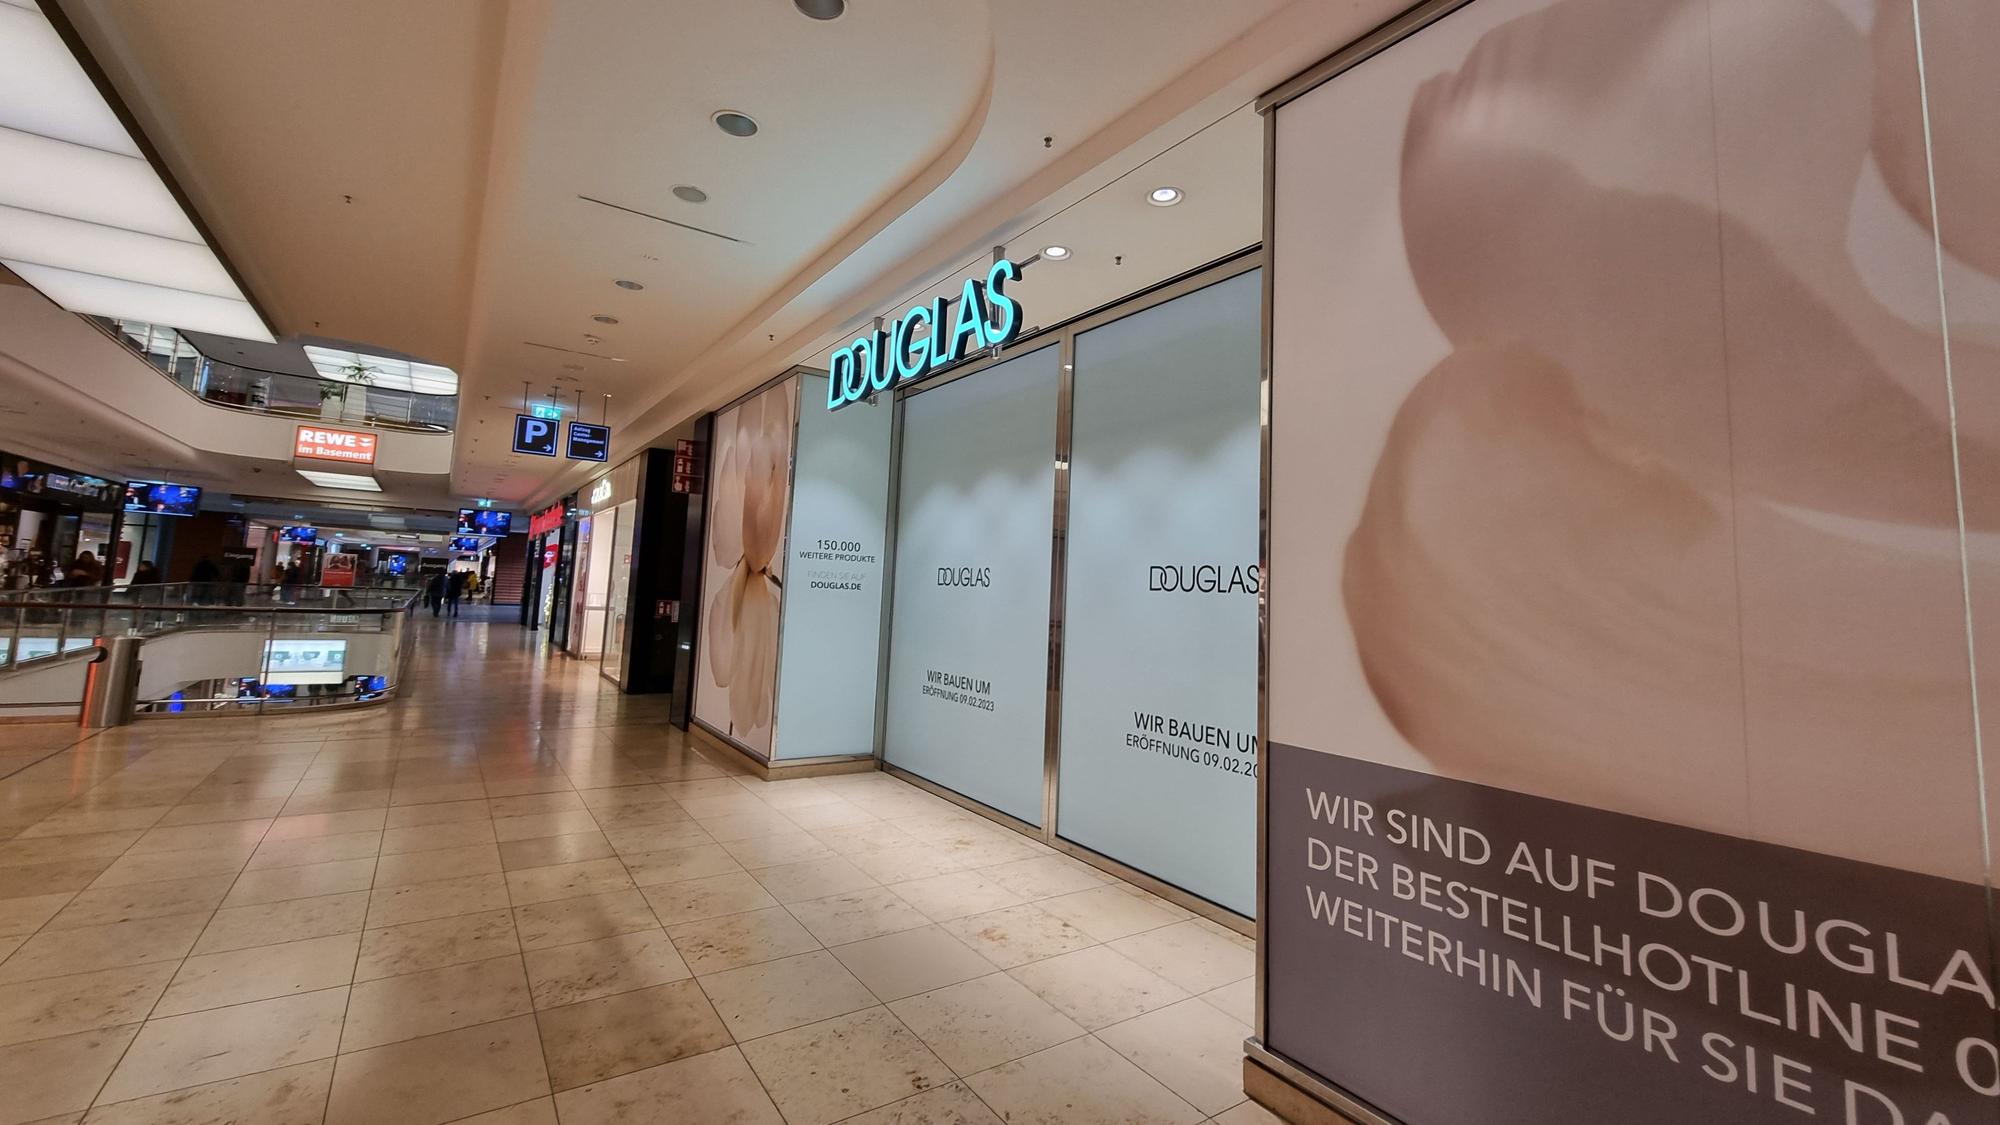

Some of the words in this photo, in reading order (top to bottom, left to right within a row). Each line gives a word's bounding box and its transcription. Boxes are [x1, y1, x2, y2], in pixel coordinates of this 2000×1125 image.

[827, 259, 1021, 411] DOUGLAS
[299, 429, 357, 447] REWE
[524, 419, 548, 444] P
[572, 436, 605, 445] Management
[297, 444, 313, 454] im
[316, 446, 372, 460] Basement
[800, 551, 833, 561] WEITERE
[834, 553, 876, 563] PRODUKTE
[817, 539, 861, 552] 150.000
[810, 580, 862, 591] DOUGLAS.DE
[937, 567, 991, 587] DOUGLAS
[1149, 564, 1260, 594] DOUGLAS
[927, 669, 942, 685] WIR
[943, 672, 974, 691] BAUEN
[975, 679, 991, 695] UM
[922, 684, 959, 703] ERÖFFNUNG
[959, 694, 995, 712] 09.02.2023
[1134, 711, 1164, 734] WIR
[1168, 718, 1230, 749] BAUEN
[1236, 732, 1258, 755] U
[1126, 733, 1200, 763] ERÖFFNUNG
[1305, 787, 1375, 837] WIR
[1385, 808, 1492, 866] SIND
[1504, 841, 1617, 900] AUF
[1637, 871, 2000, 1011] DOUGLA
[1307, 836, 1379, 890] DER
[1392, 862, 1924, 1074] BESTELLHOTLINE
[1305, 884, 1542, 1009] WEITERHIN
[1563, 978, 1681, 1064] FÜR
[1701, 1031, 1817, 1116] SIE
[1843, 1078, 1953, 1125] D
